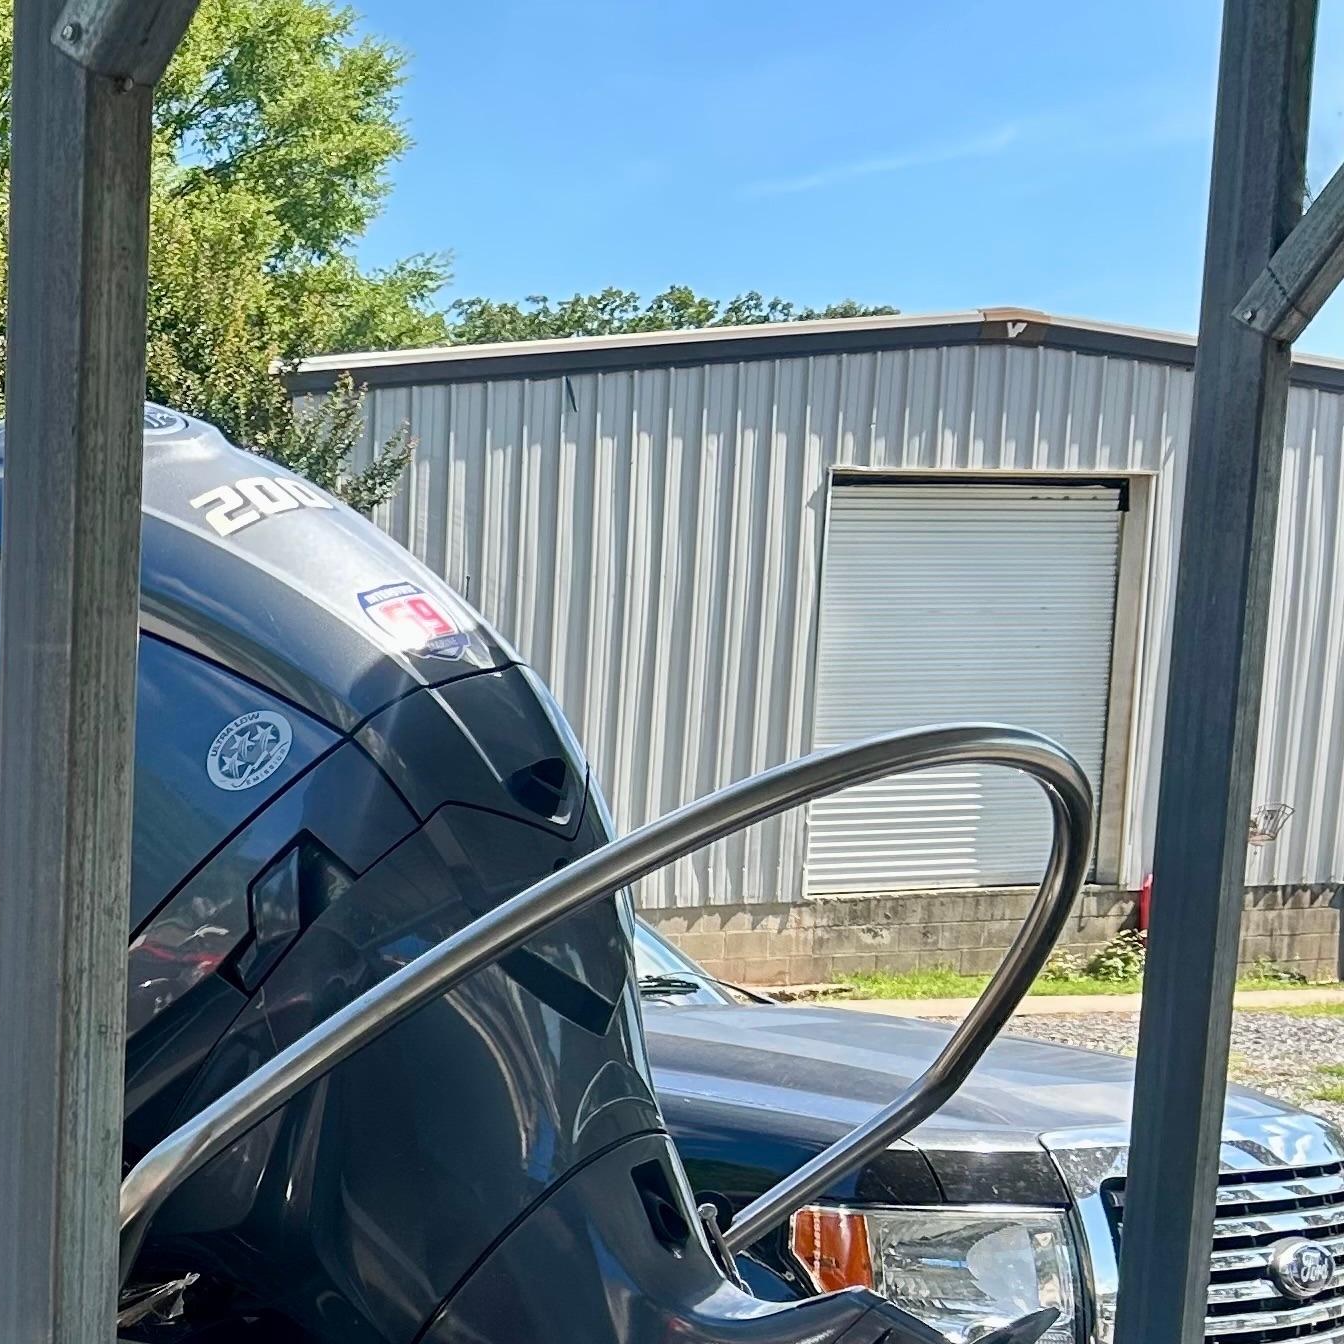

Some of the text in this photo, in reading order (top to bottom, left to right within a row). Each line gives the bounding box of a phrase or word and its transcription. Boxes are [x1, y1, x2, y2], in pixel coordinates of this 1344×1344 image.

[189, 475, 334, 537] 200
[210, 712, 261, 758] ULTRA LOW
[1300, 1251, 1329, 1283] Ford
